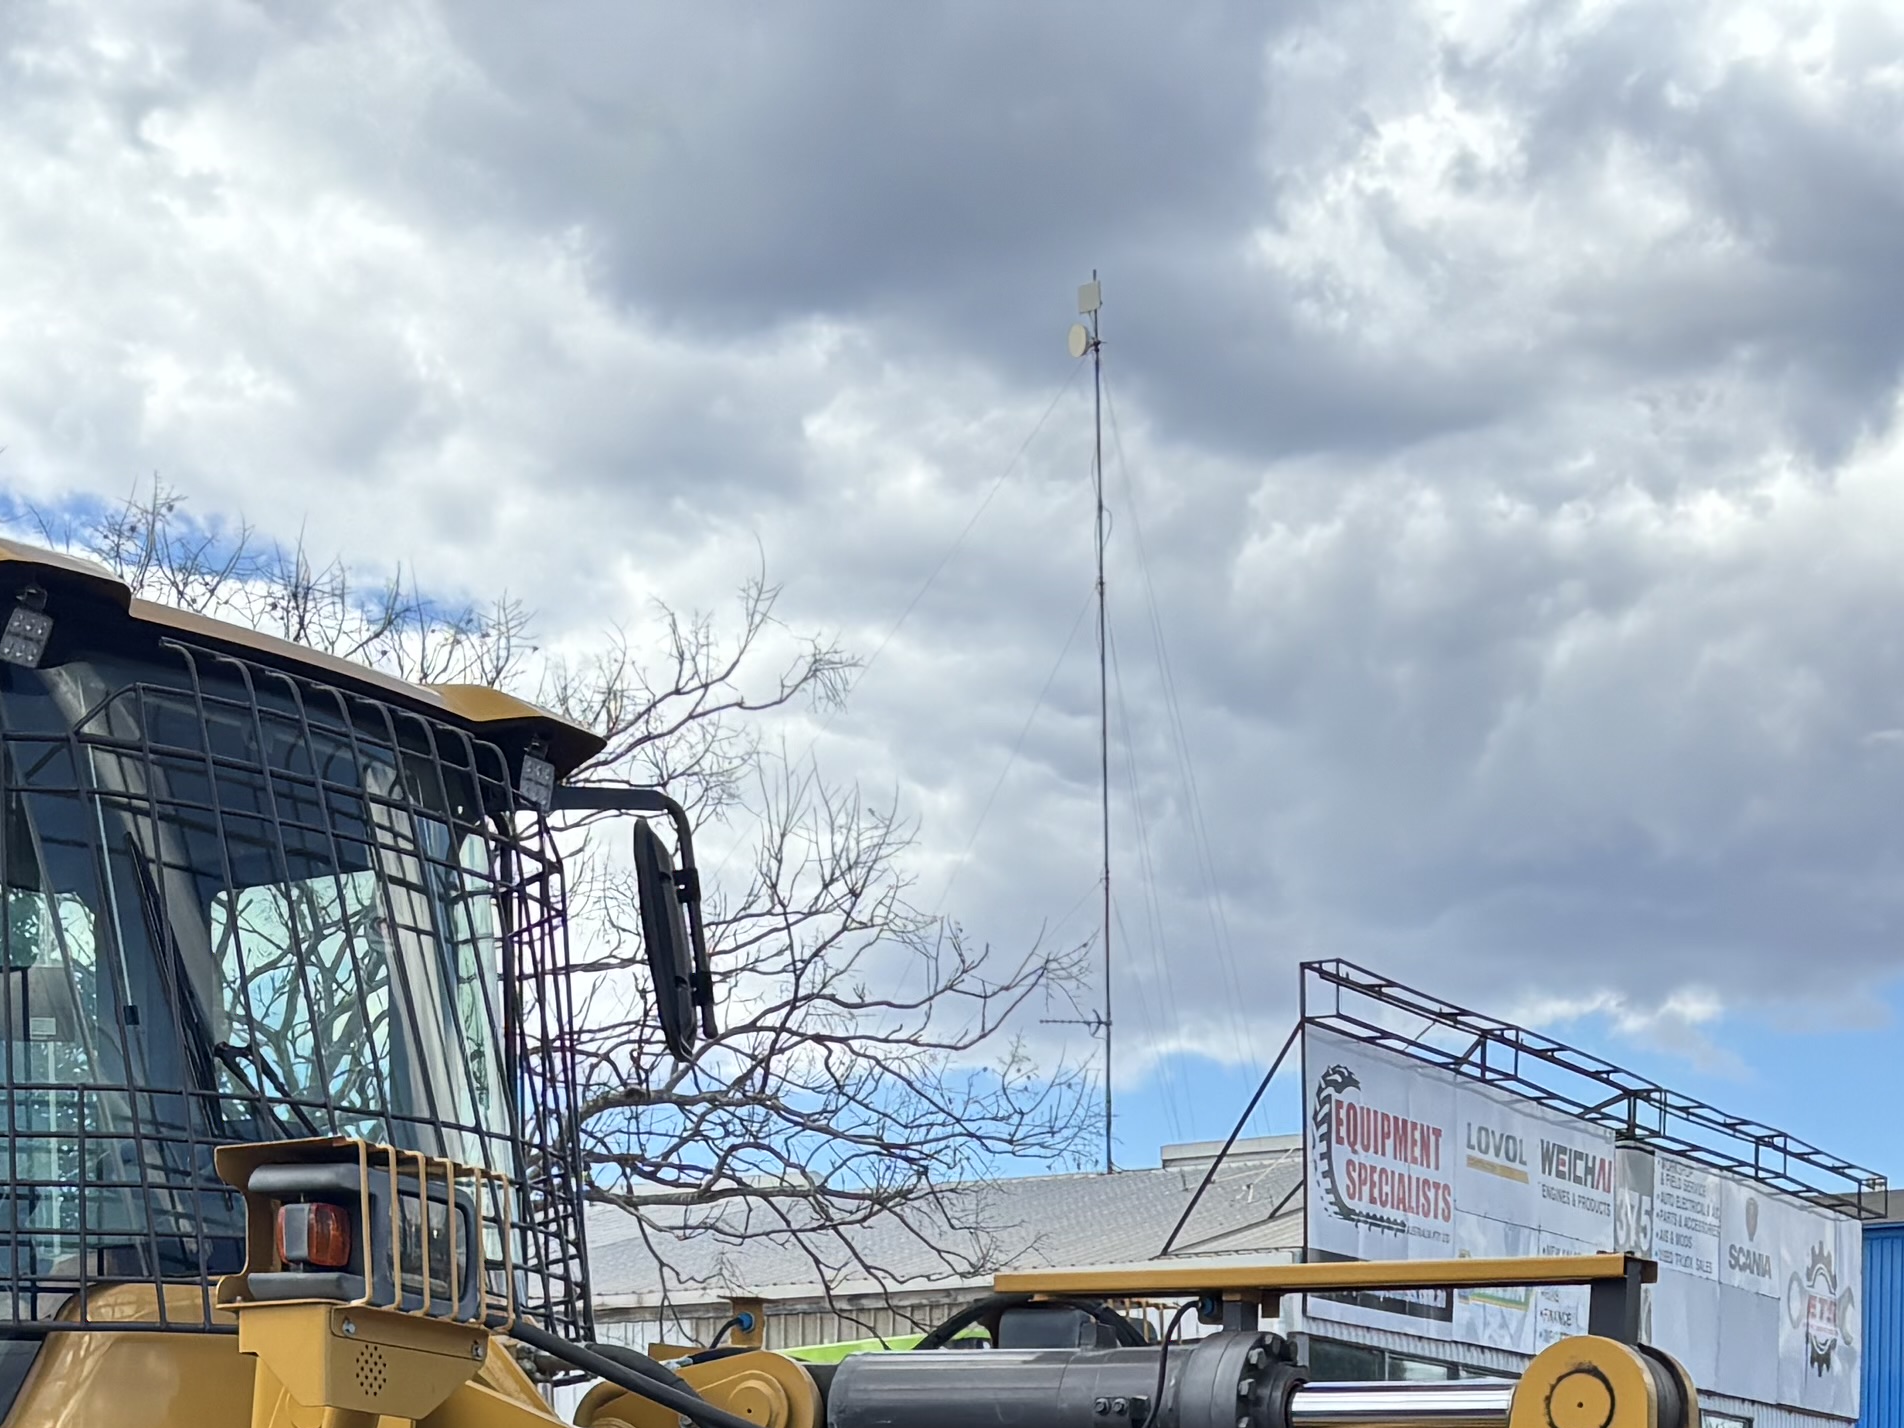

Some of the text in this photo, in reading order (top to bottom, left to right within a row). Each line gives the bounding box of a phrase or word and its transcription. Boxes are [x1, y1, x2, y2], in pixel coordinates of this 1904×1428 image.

[1334, 1099, 1442, 1171] EQUIPMENT
[1467, 1122, 1527, 1166] LOVOL
[1346, 1158, 1451, 1223] SPECIALISTS
[1540, 1138, 1612, 1194] WEICHAI
[1542, 1184, 1570, 1205] ENGINES
[1577, 1194, 1611, 1217] PRODUCTS
[1728, 1243, 1772, 1279] SCANIA
